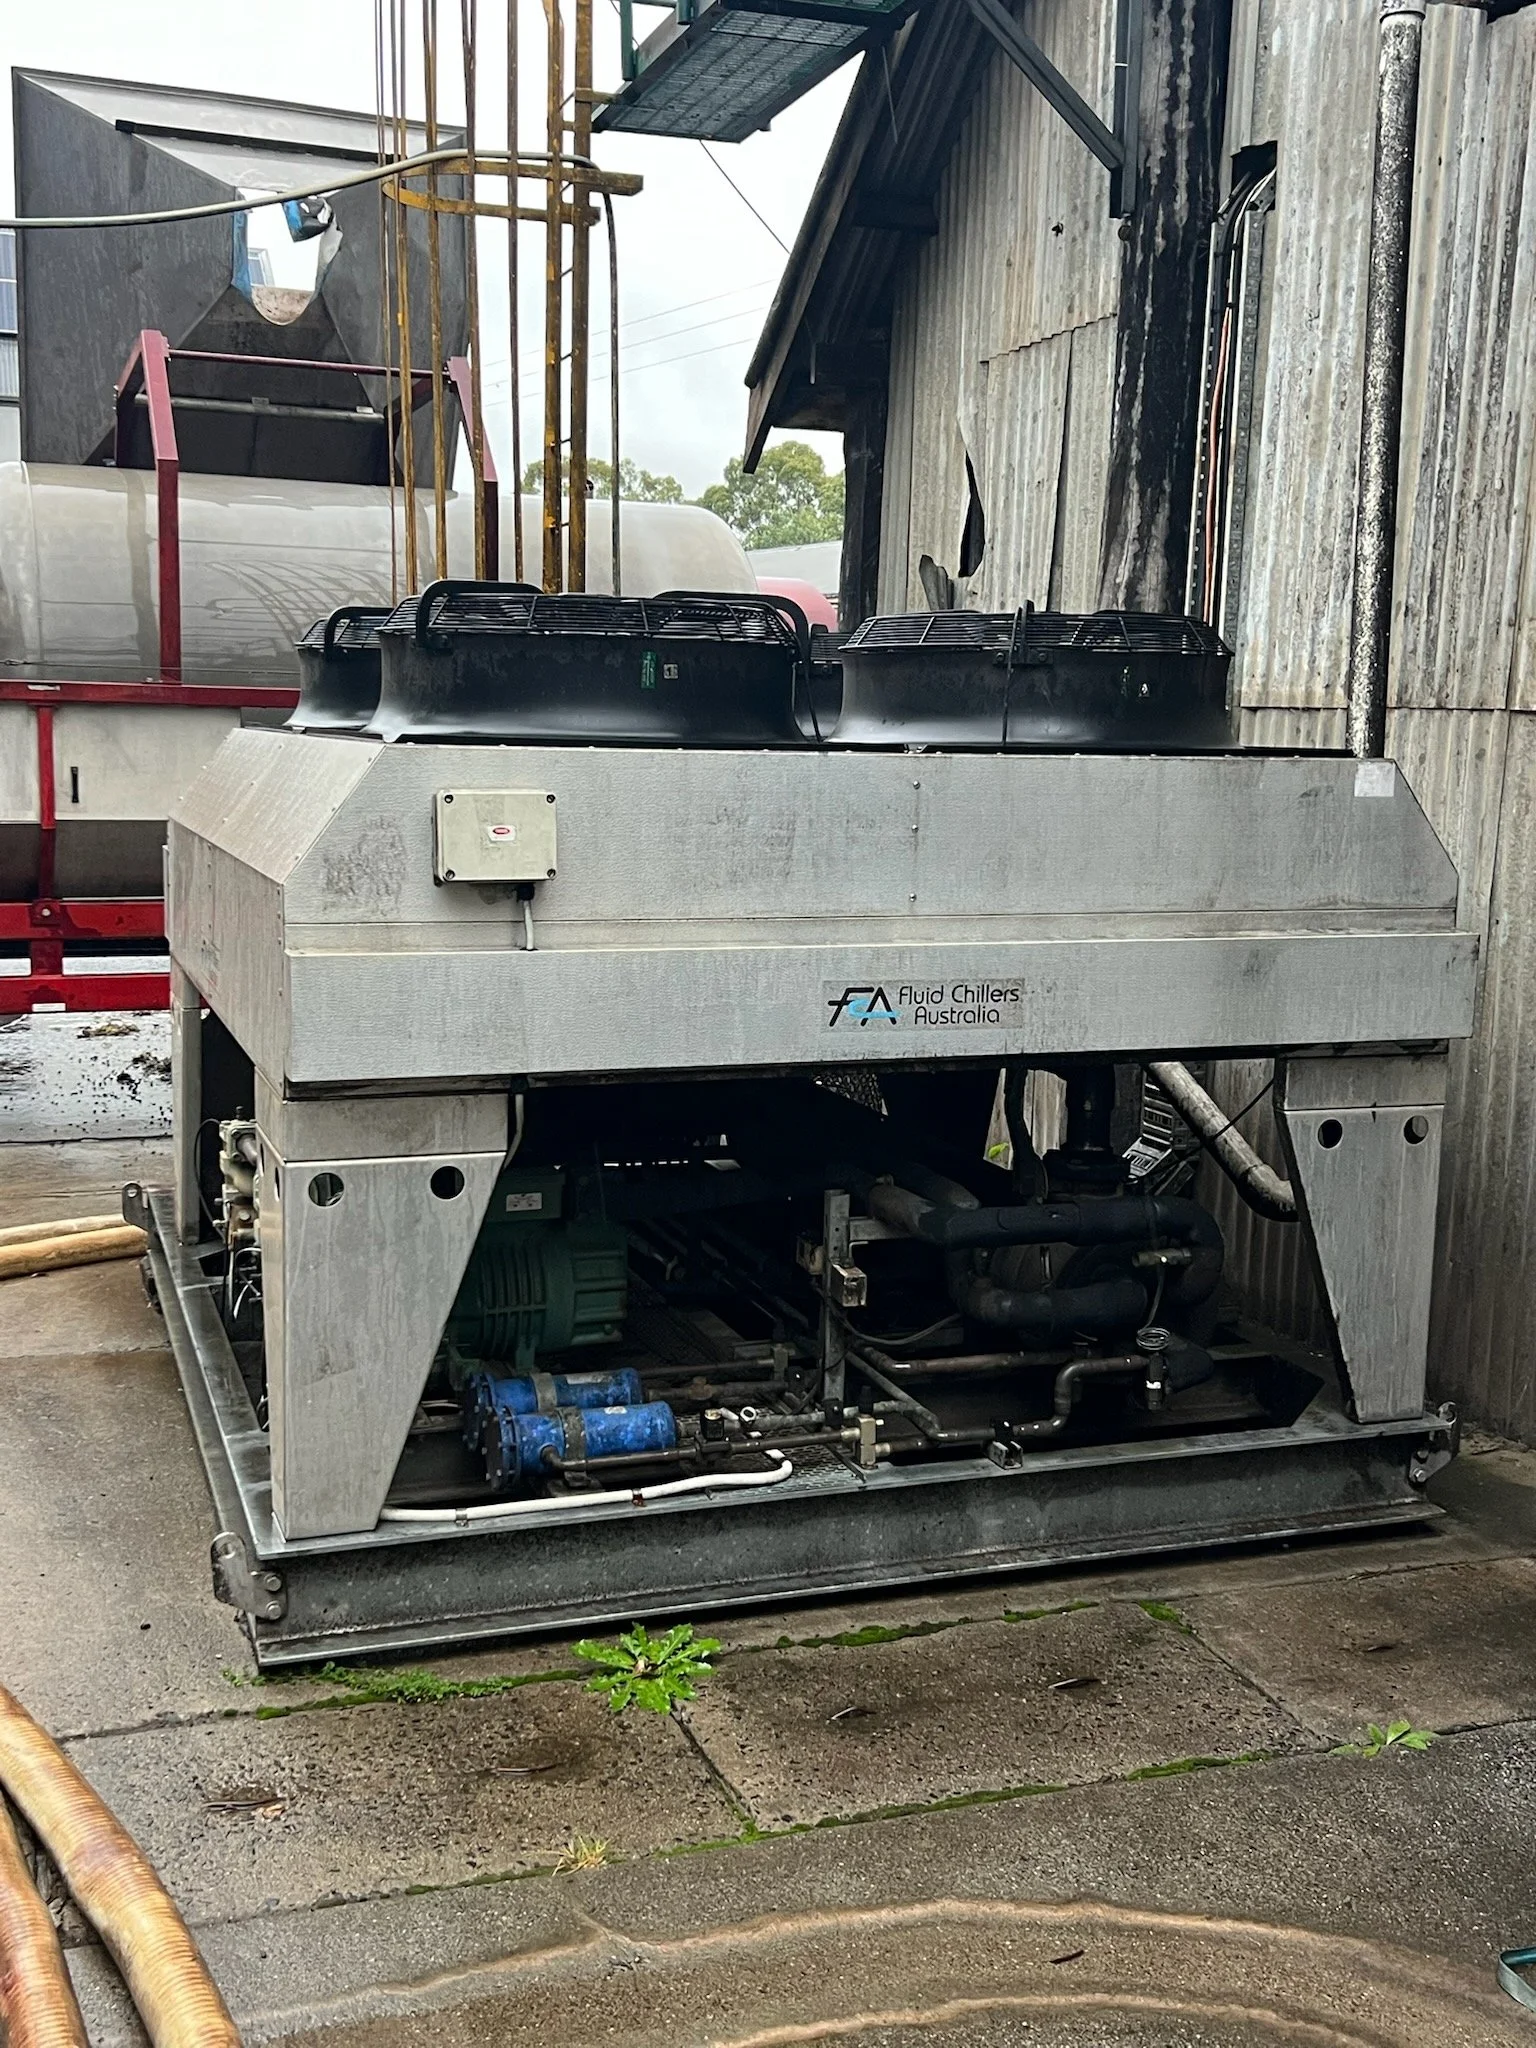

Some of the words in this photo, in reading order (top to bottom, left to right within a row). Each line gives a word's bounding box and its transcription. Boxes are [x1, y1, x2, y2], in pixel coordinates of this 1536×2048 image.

[899, 985, 944, 1005] Fluid
[951, 984, 1020, 1004] Chillers
[914, 1004, 1001, 1025] Australia
